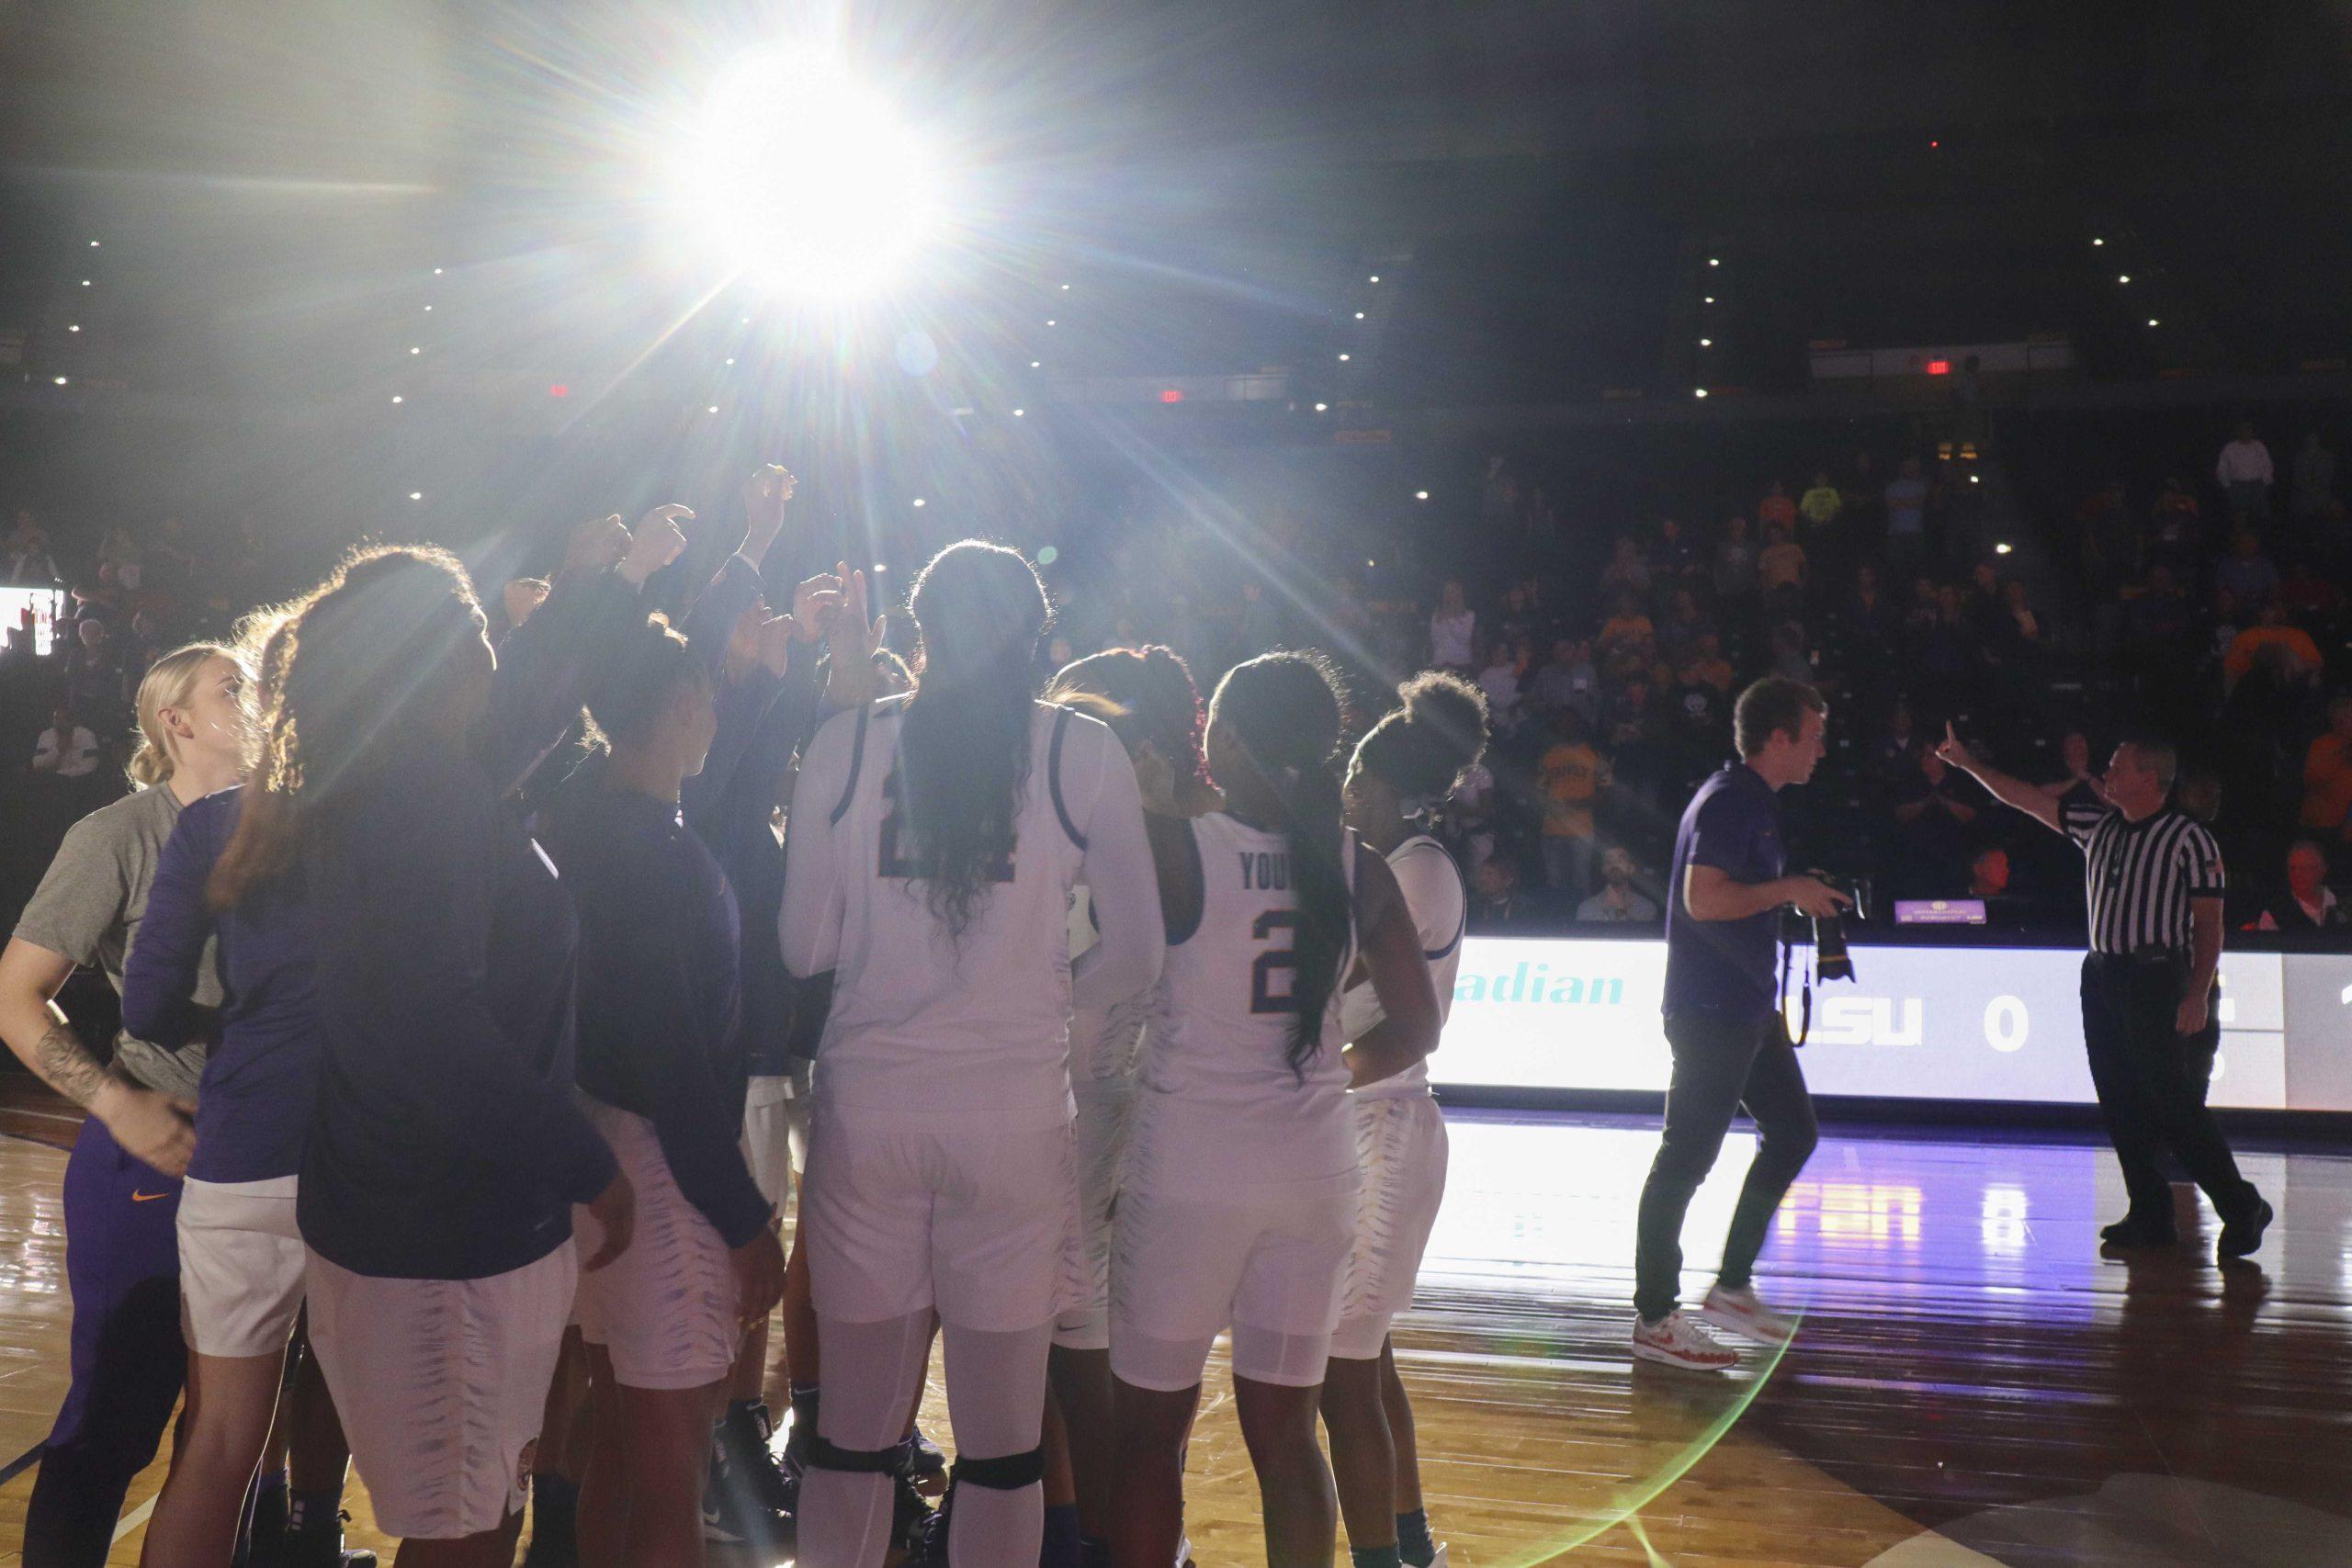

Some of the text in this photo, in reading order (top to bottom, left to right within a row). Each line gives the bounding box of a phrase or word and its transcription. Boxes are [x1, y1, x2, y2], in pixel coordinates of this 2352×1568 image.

[1250, 908, 1311, 1013] 2
[1453, 962, 1623, 1005] adian
[1783, 995, 2029, 1053] LSU 0
